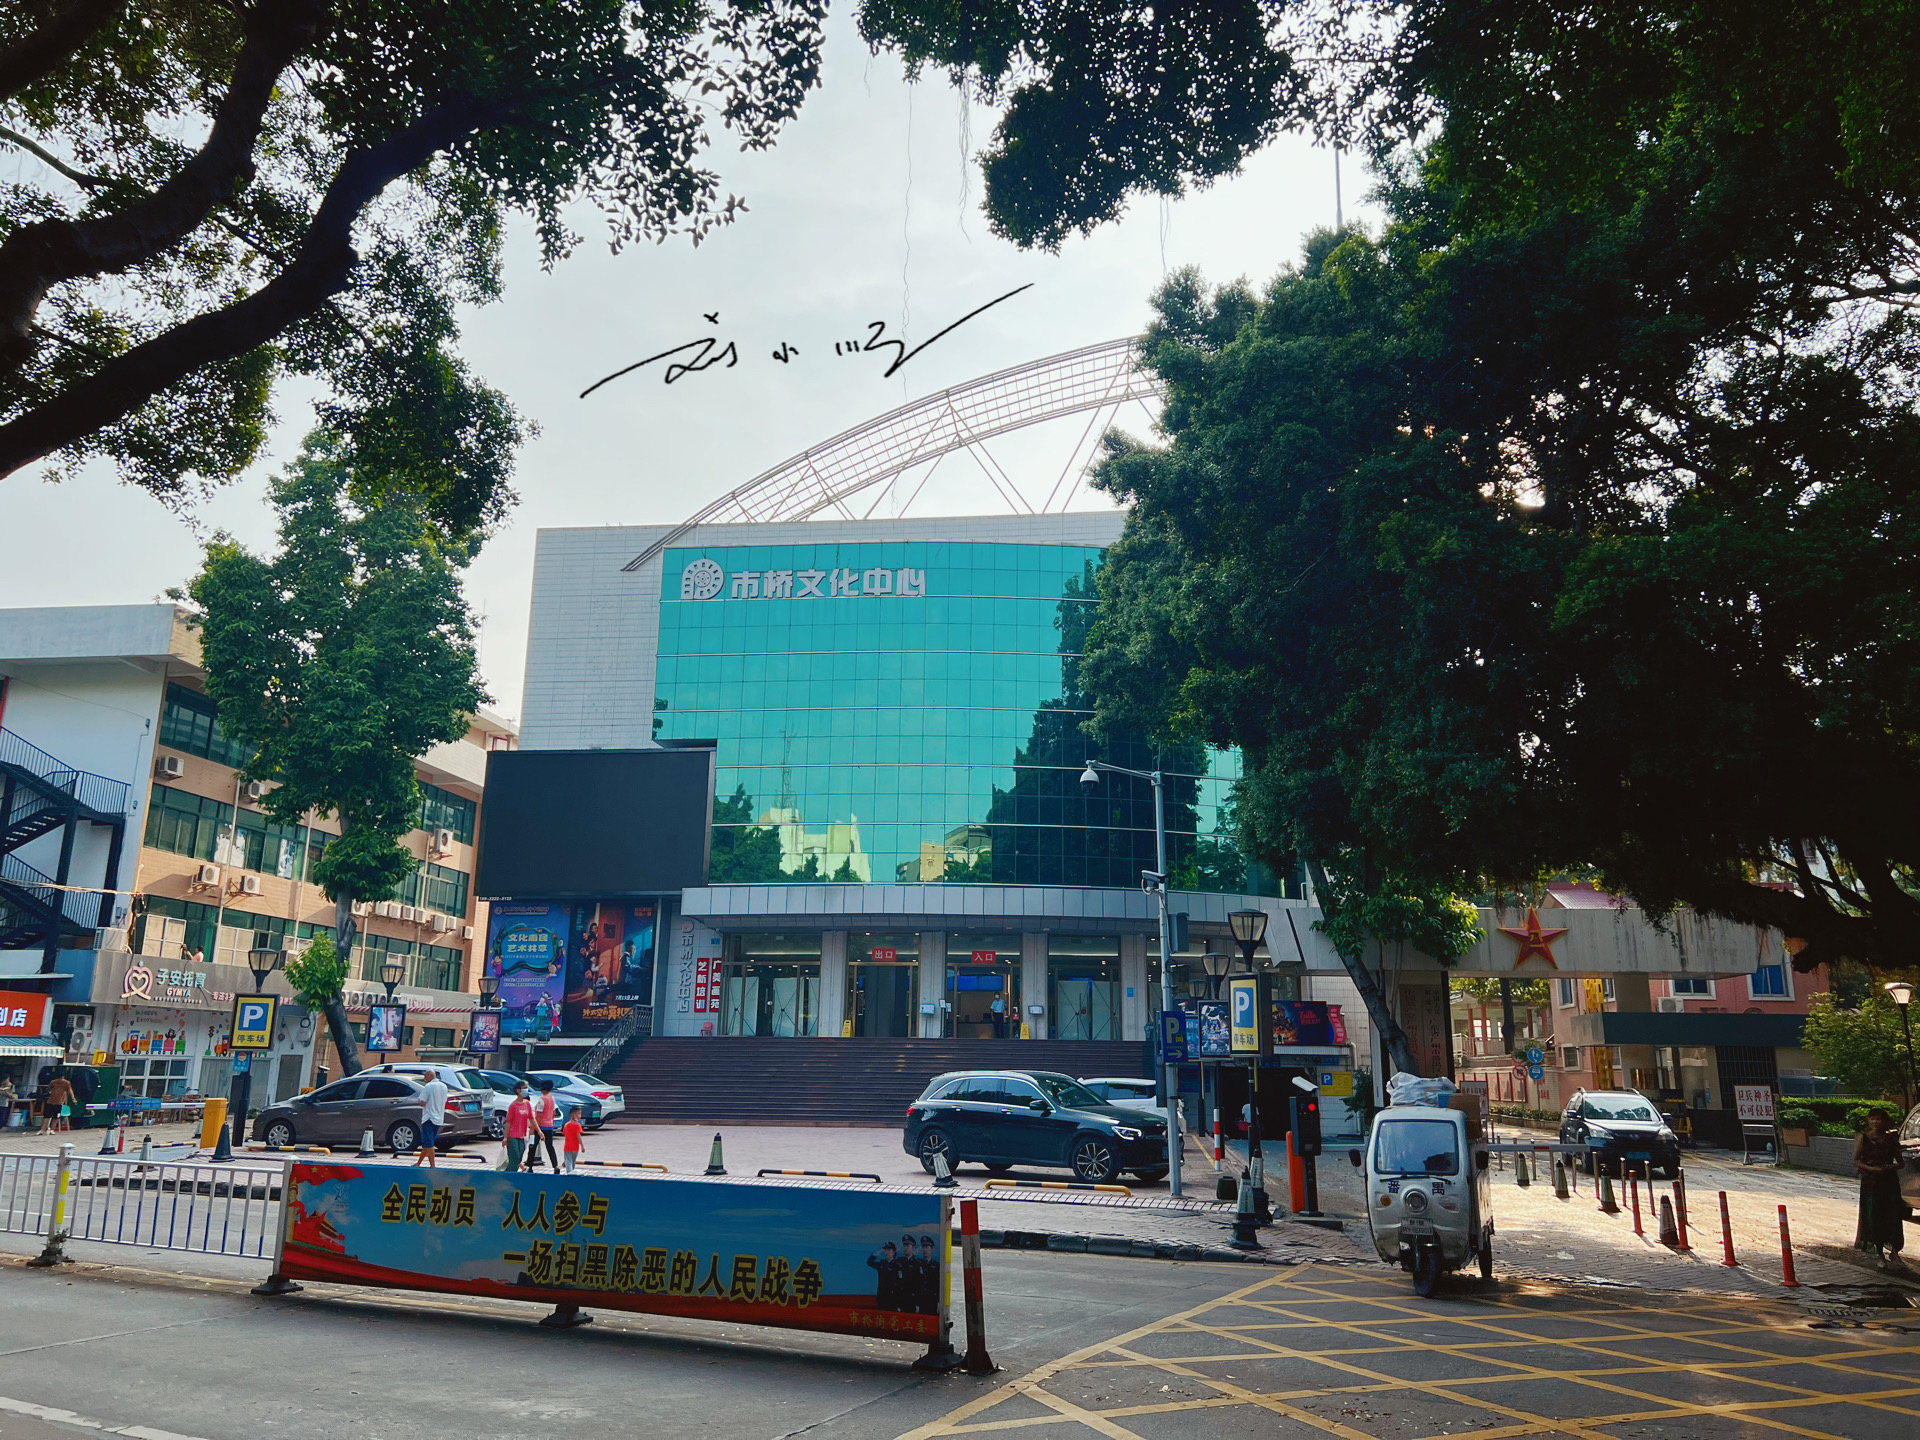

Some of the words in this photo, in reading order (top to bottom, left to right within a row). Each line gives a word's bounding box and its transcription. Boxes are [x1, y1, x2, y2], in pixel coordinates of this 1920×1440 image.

[731, 567, 927, 599] 市桥文化中心
[874, 950, 894, 959] 出口
[974, 953, 993, 961] 入口
[157, 968, 207, 988] 子安托育
[677, 935, 694, 1013] 市桥文化中心
[695, 961, 708, 1009] 艺新培训
[243, 1005, 264, 1028] P
[1235, 990, 1250, 1024] P
[237, 1034, 266, 1043] 停车场
[1165, 1017, 1180, 1044] P
[1234, 1033, 1255, 1046] 停车场
[1323, 1074, 1331, 1083] P
[1738, 1089, 1772, 1102] 卫兵神圣
[1738, 1104, 1774, 1117] 不可侵犯
[1388, 1180, 1401, 1194] 番
[1432, 1182, 1446, 1196] 禺
[380, 1182, 477, 1228] 全民动员
[501, 1187, 610, 1238] 人人参与
[501, 1239, 826, 1310] 一场扫黑除恶的人民战争
